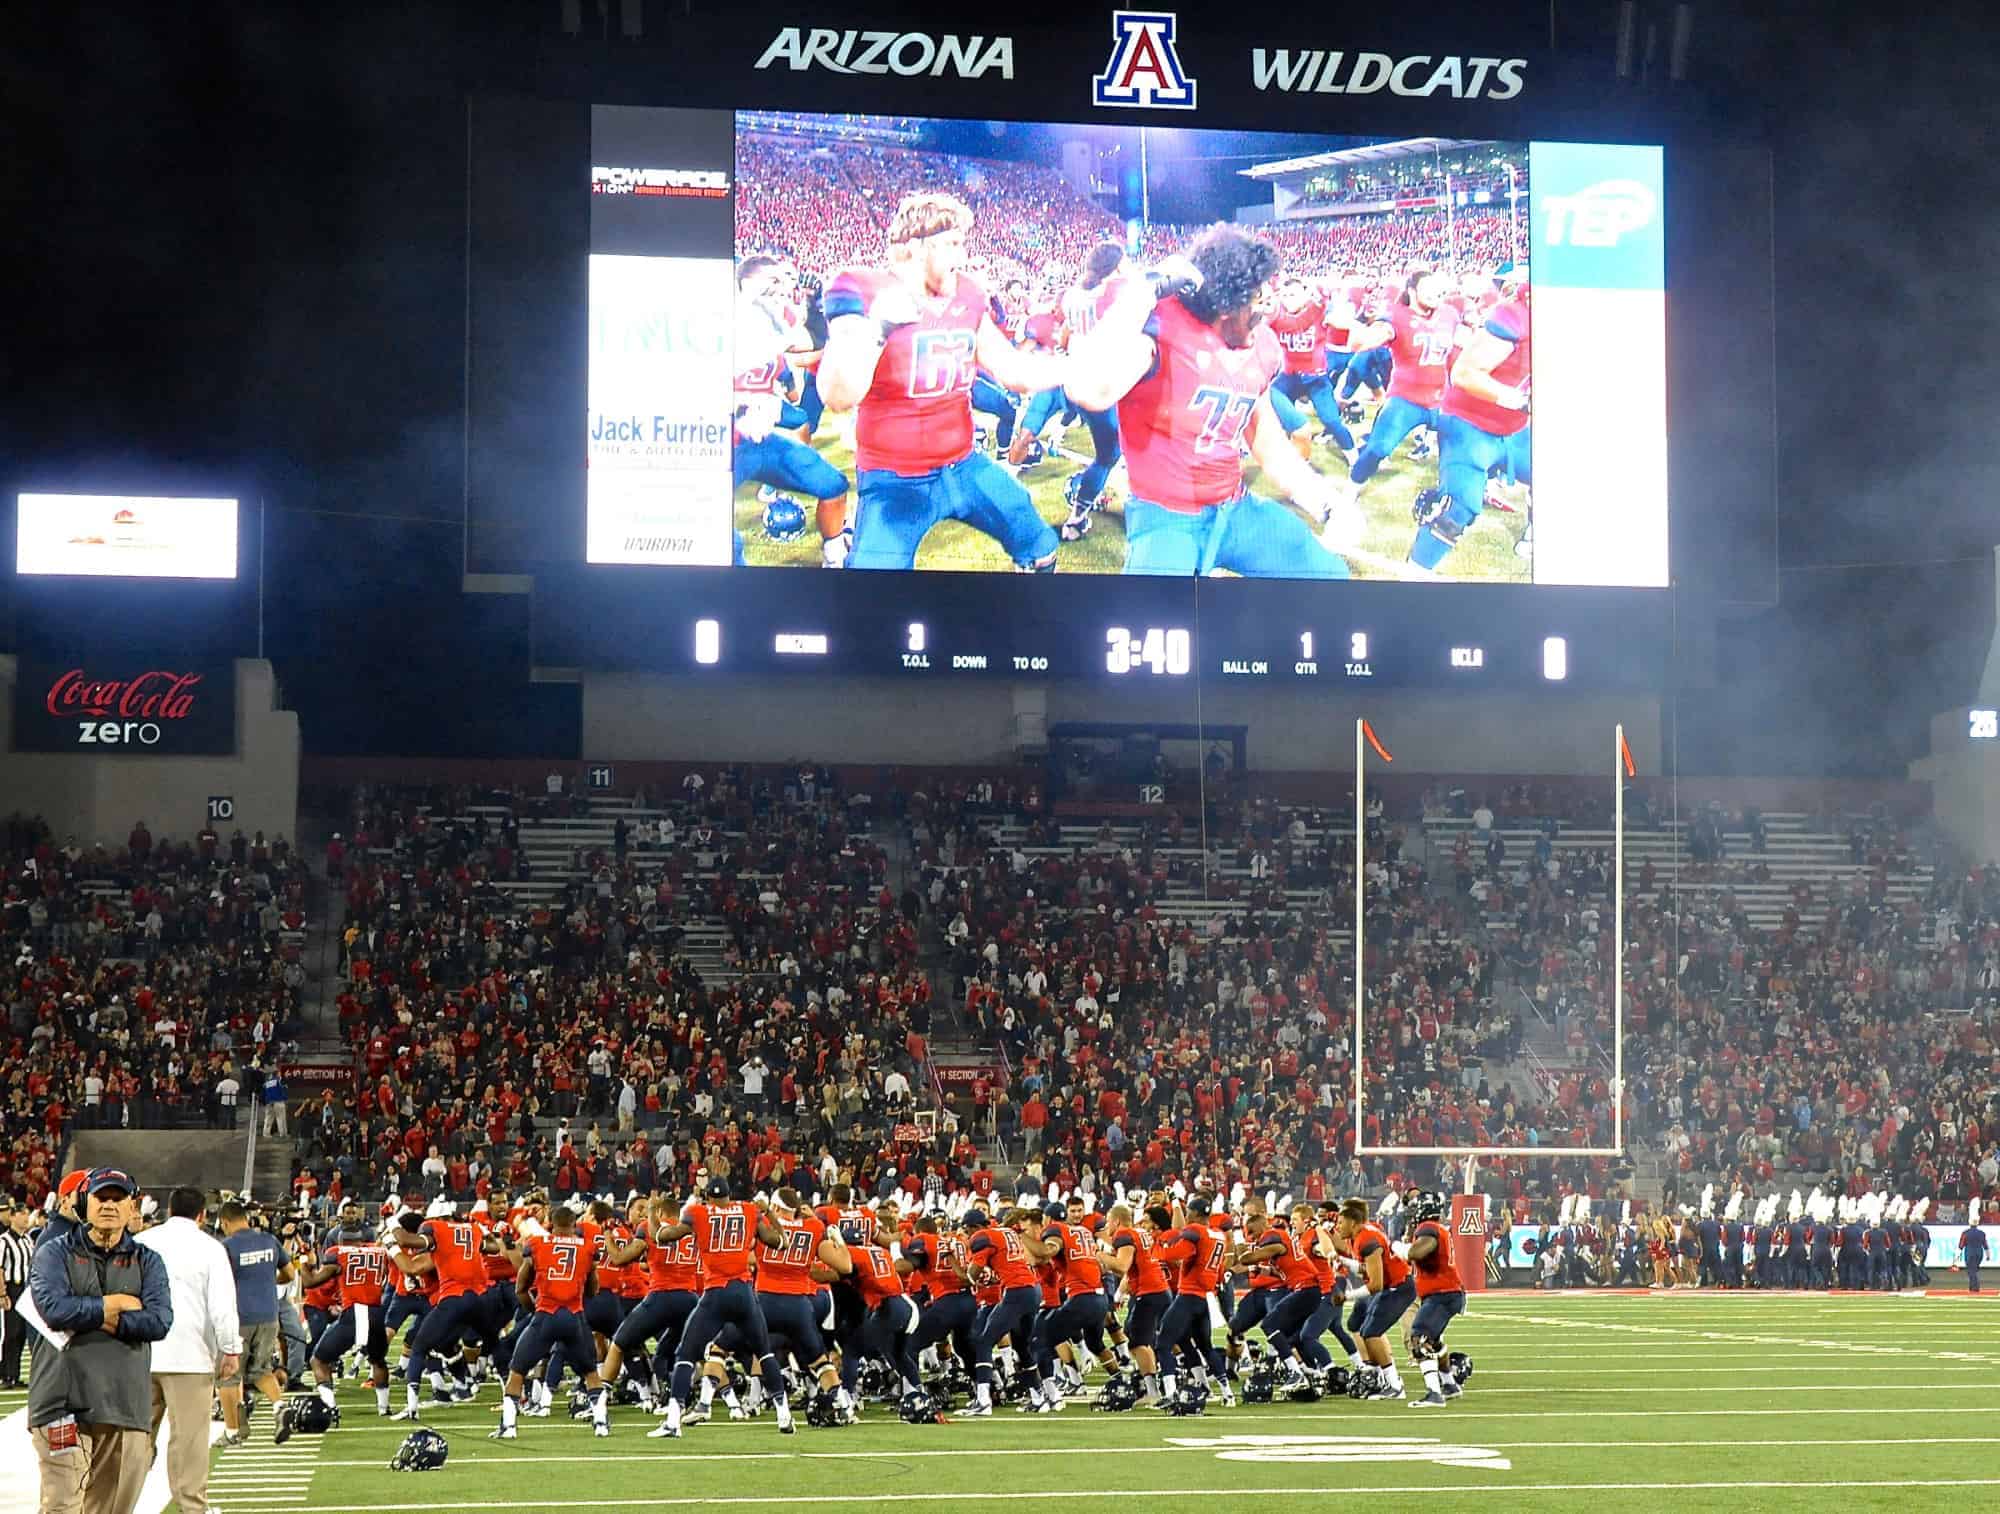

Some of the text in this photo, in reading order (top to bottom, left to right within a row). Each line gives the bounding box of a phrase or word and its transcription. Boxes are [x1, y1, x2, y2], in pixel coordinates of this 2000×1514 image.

[754, 27, 1014, 80] ARIZONA
[1252, 48, 1528, 100] WILDCATS
[591, 414, 727, 444] Jack Furrier
[1106, 628, 1190, 674] 3:40
[1301, 631, 1312, 659] 1
[953, 655, 987, 669] DOWN
[1013, 656, 1029, 670] TO
[1223, 661, 1268, 674] BALL ON
[1295, 662, 1317, 674] QTR
[79, 721, 161, 744] zero
[591, 768, 610, 787] 11
[1142, 785, 1163, 803] 12
[208, 800, 233, 819] 10
[948, 1070, 978, 1080] SECTION
[454, 1226, 474, 1261] 4
[708, 1215, 746, 1252] 18
[240, 1249, 274, 1266] ESPN
[345, 1251, 385, 1286] 24
[547, 1244, 578, 1281] 3
